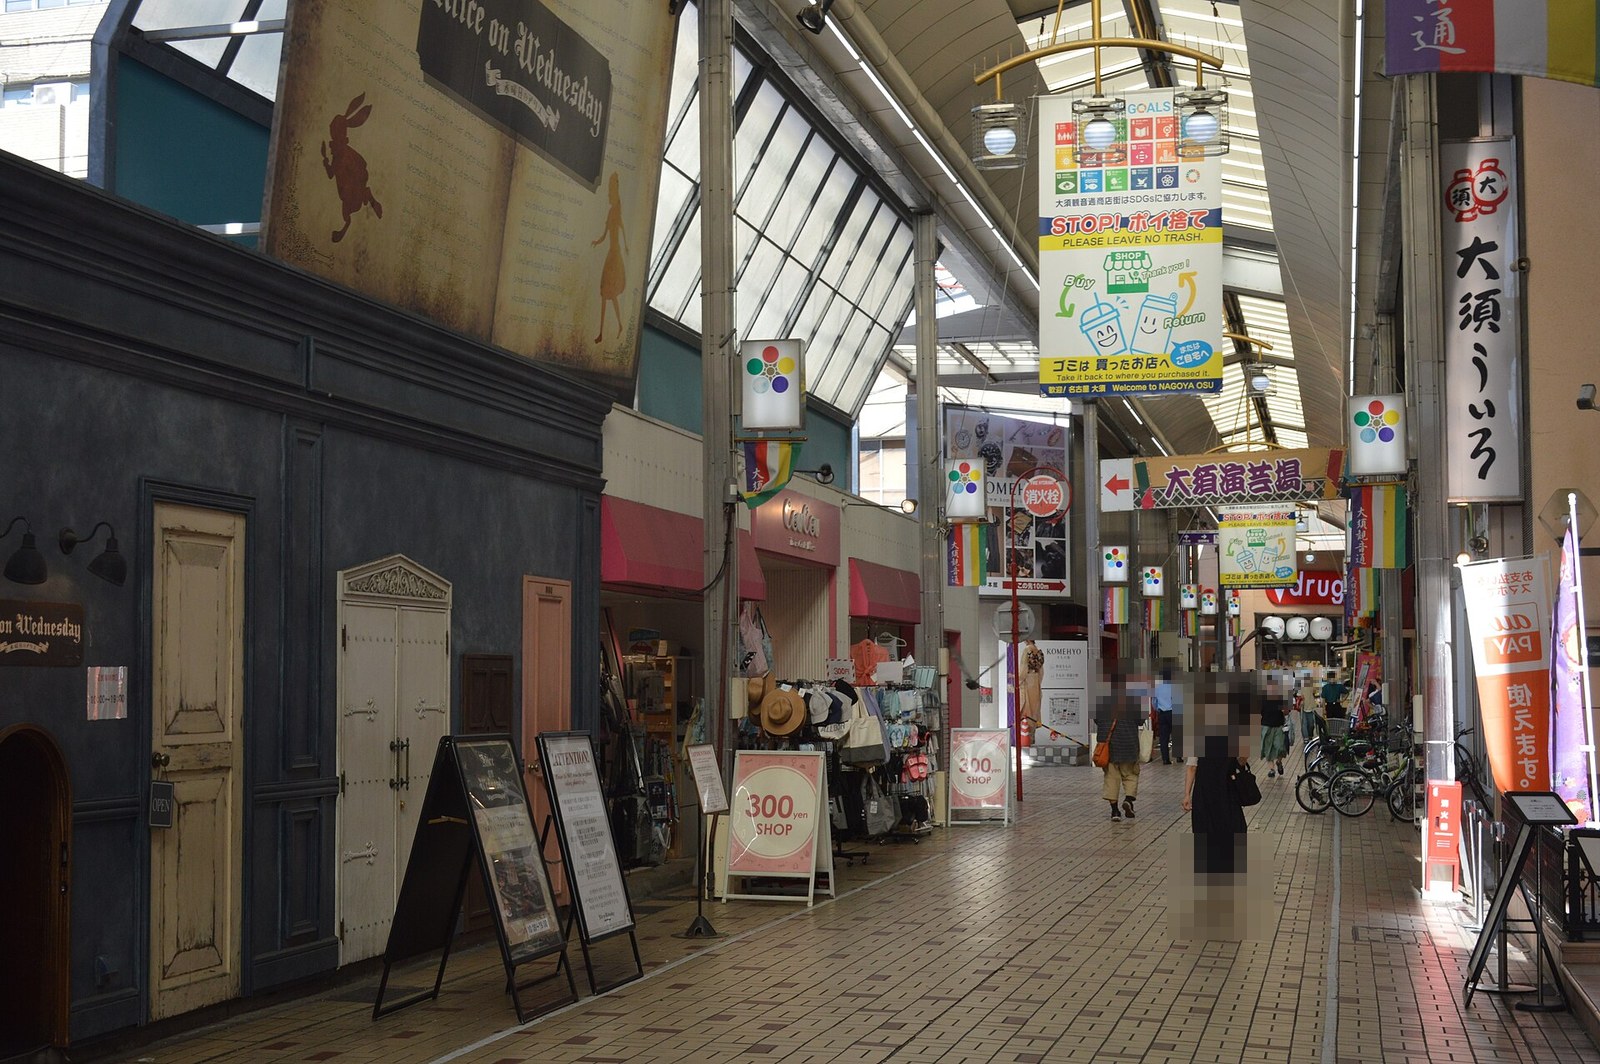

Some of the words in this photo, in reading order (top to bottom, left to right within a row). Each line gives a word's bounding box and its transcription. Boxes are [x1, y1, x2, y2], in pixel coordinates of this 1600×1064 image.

[1411, 0, 1466, 54] 通
[488, 18, 510, 56] on
[514, 21, 602, 137] Wednesday
[1127, 101, 1171, 114] GOALS
[1479, 176, 1497, 194] 大
[1452, 187, 1470, 206] 須
[1051, 214, 1121, 236] STOP!
[1128, 210, 1208, 232] ポイ捨て
[1063, 237, 1104, 247] PLEASE
[1107, 235, 1142, 245] LEAVE
[1144, 234, 1161, 243] NO
[1164, 232, 1204, 242] TRASH.
[1115, 252, 1142, 260] SHOP
[1141, 265, 1168, 280] Thank
[1168, 261, 1184, 274] you
[1064, 274, 1095, 290] Buy
[1163, 312, 1206, 329] Return
[1053, 359, 1090, 372] ゴミは
[1095, 357, 1170, 372] 買ったお店へ
[1175, 350, 1210, 366] ご自宅へ
[1456, 236, 1501, 480] 大須ういろ
[1115, 371, 1139, 380] where
[1158, 370, 1200, 378] purchased
[1112, 383, 1147, 391] Welcome
[1196, 381, 1214, 389] OSU
[1164, 459, 1302, 499] 大須演芸場
[1026, 488, 1060, 505] 消火栓
[1289, 571, 1344, 604] drug
[16, 613, 81, 643] Wednesday
[966, 776, 992, 785] SHOP
[745, 794, 794, 819] 300
[793, 812, 809, 820] yen
[756, 823, 793, 836] SHOP
